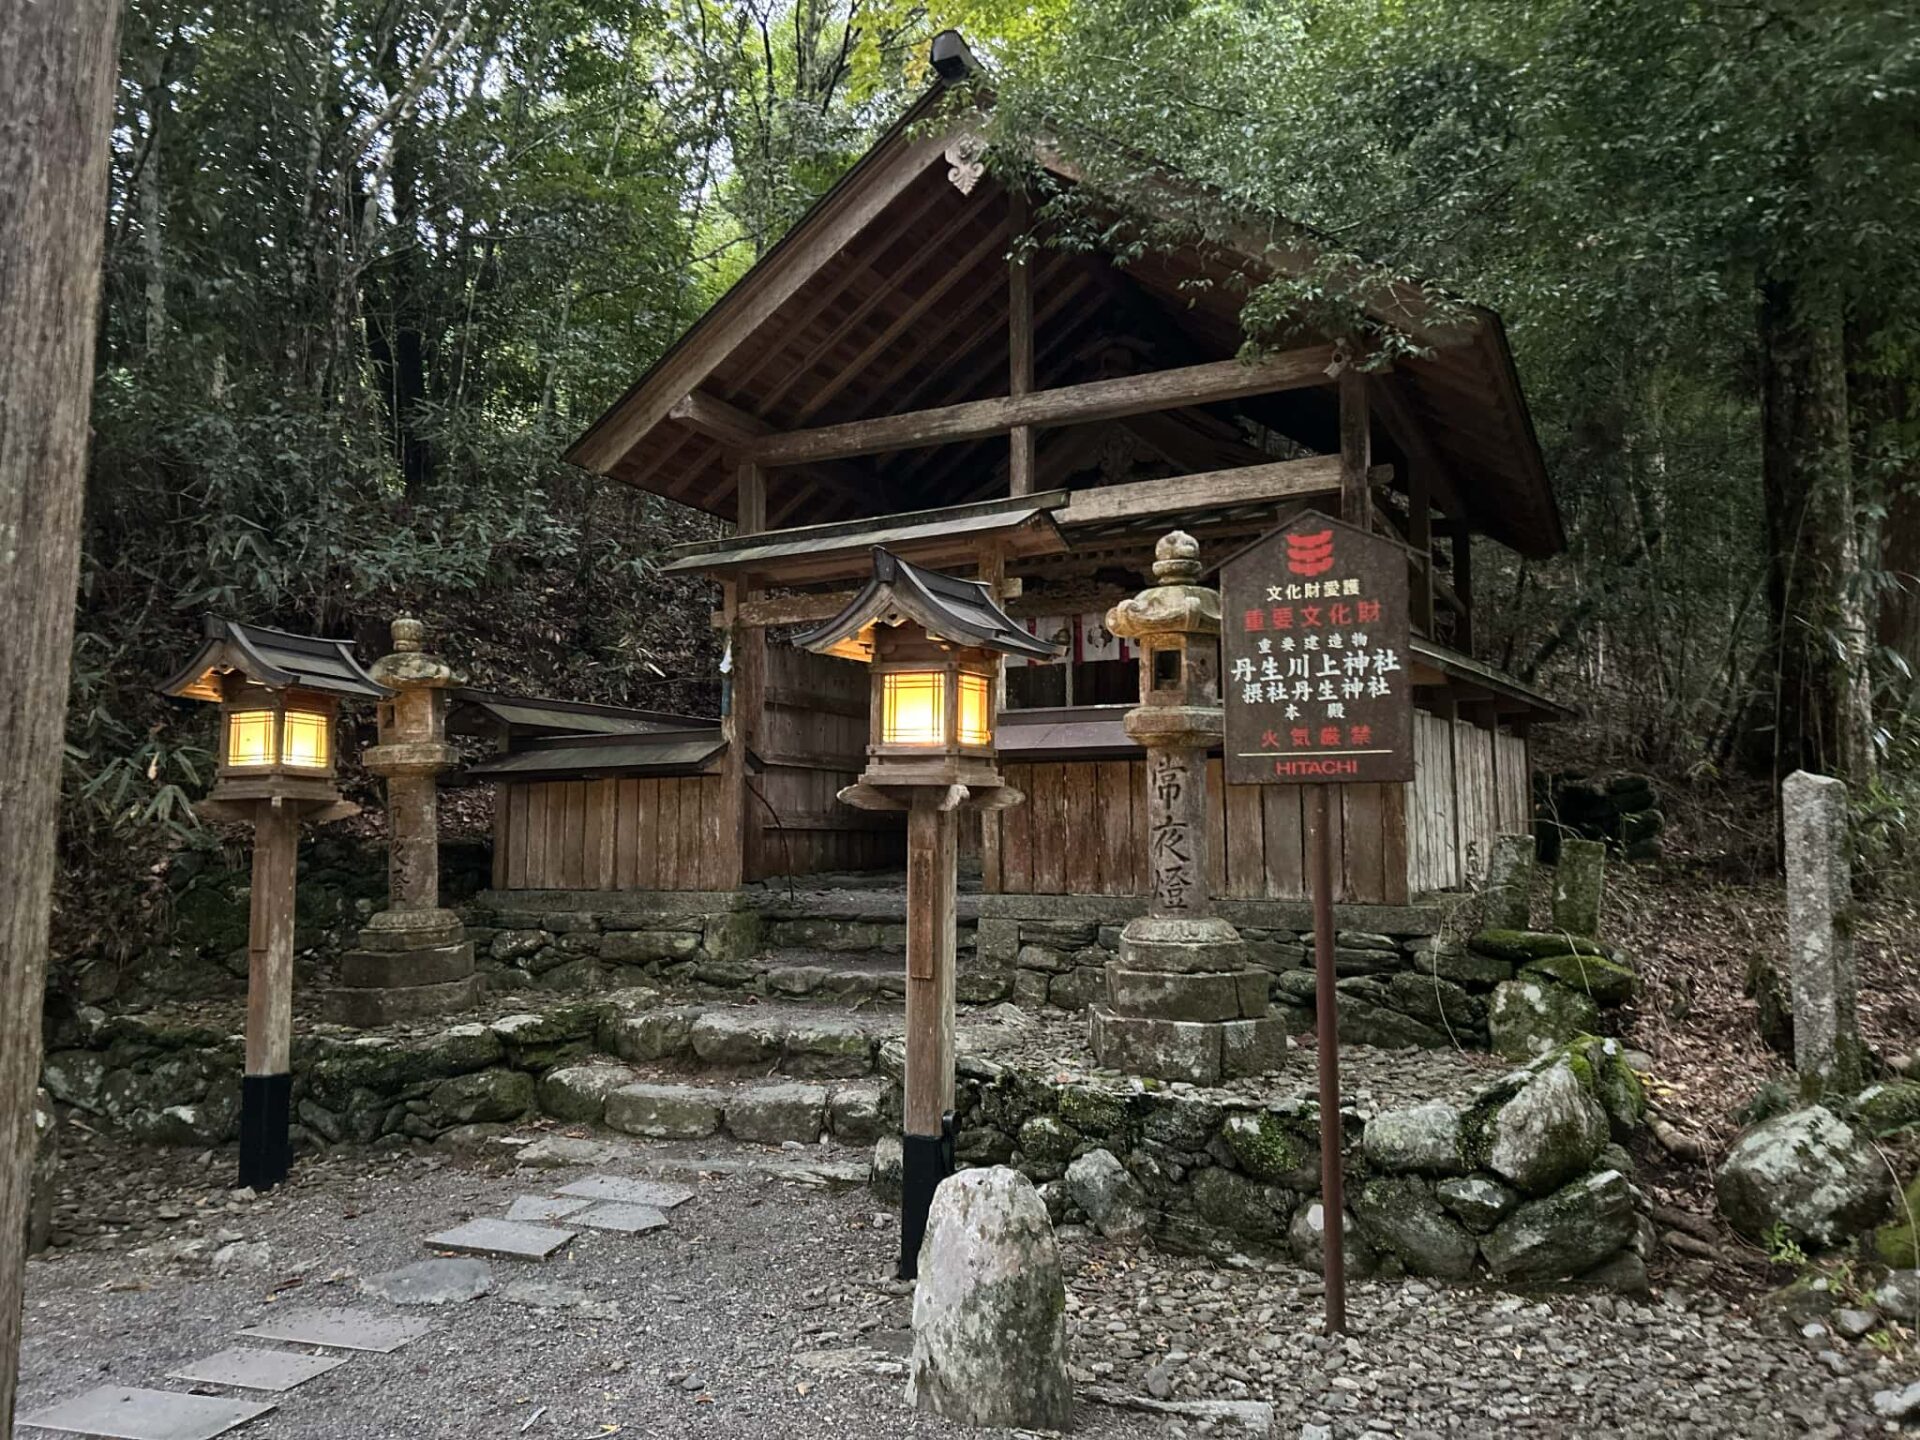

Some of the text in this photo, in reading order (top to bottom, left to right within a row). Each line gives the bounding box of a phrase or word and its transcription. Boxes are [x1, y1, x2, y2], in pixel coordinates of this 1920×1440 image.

[1266, 578, 1360, 601] 文化財愛護
[1244, 600, 1381, 632] 重要文化財
[1257, 631, 1368, 654] 重要建造物
[1231, 648, 1401, 682] 丹生川上神社
[1261, 724, 1372, 748] 火気厳禁
[1276, 760, 1358, 776] HITACHI
